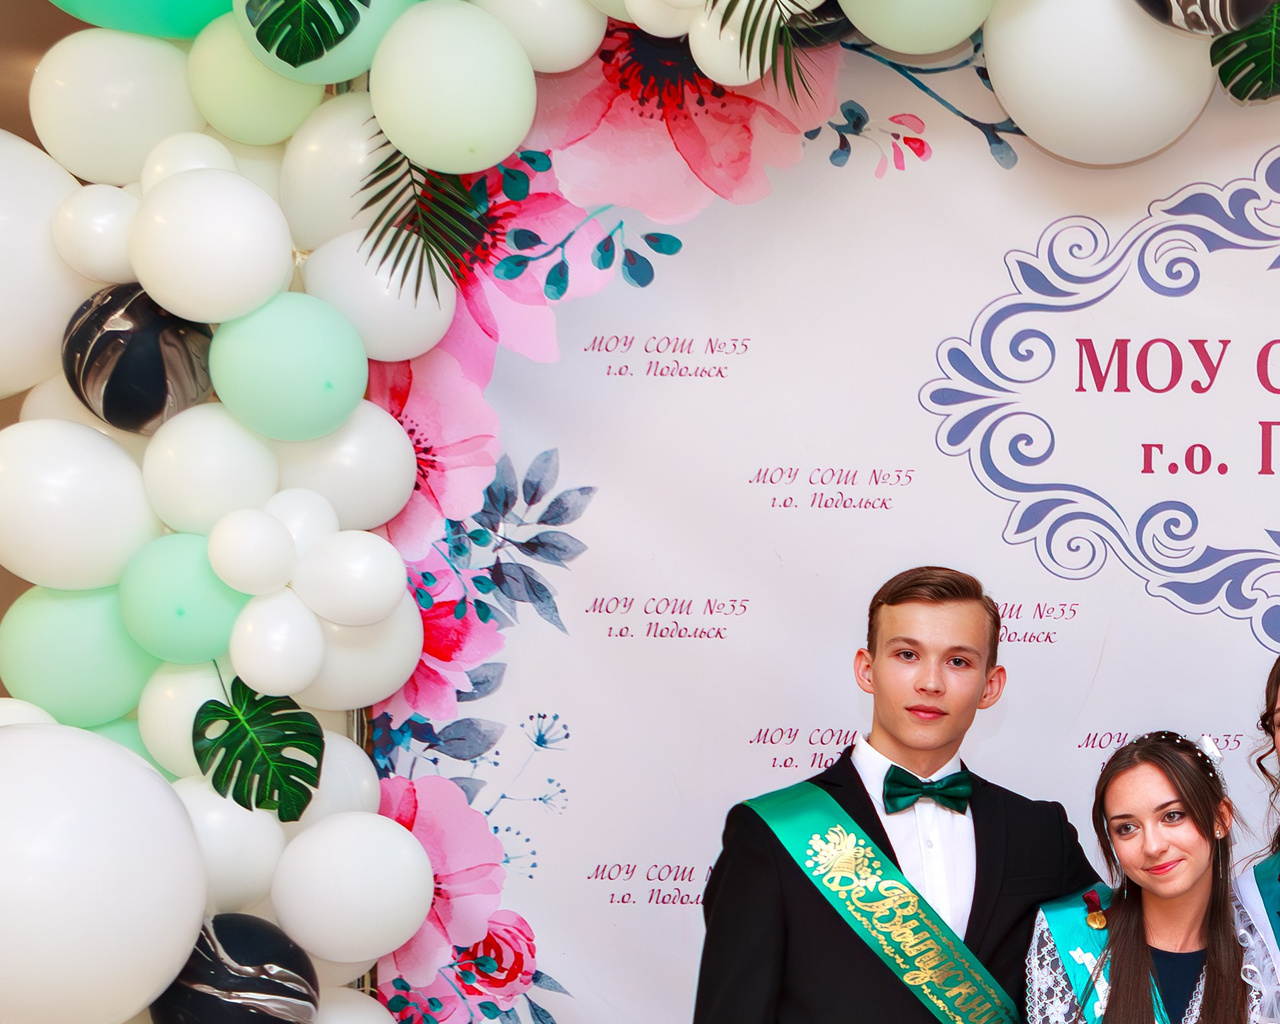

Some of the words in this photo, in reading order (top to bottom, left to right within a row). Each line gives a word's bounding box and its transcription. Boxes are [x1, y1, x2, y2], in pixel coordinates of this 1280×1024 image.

[583, 334, 636, 353] МОУ
[643, 335, 694, 355] СОШ
[704, 337, 752, 355] №35
[606, 364, 634, 377] г.о.
[645, 359, 729, 379] Подольск
[1075, 337, 1232, 395] МОУ
[1140, 443, 1229, 476] г.о.
[748, 466, 800, 485] МОУ
[808, 467, 859, 486] СОШ
[868, 468, 916, 487] №35
[771, 496, 799, 509] г.о.
[810, 490, 892, 511] Подольск
[584, 596, 635, 615] МОУ
[643, 597, 693, 616] СОШ
[702, 598, 750, 617] №35
[1032, 602, 1080, 621] №35
[607, 626, 634, 638] г.о.
[645, 620, 727, 640] Подольск
[999, 624, 1058, 644] дольск
[748, 727, 800, 746] МОУ
[807, 728, 858, 747] СОШ
[1077, 731, 1129, 750] МОУ
[770, 756, 799, 769] г.о.
[586, 863, 638, 882] МОУ
[645, 864, 695, 883] СОШ
[608, 892, 637, 905] г.о.
[647, 887, 704, 906] Подол
